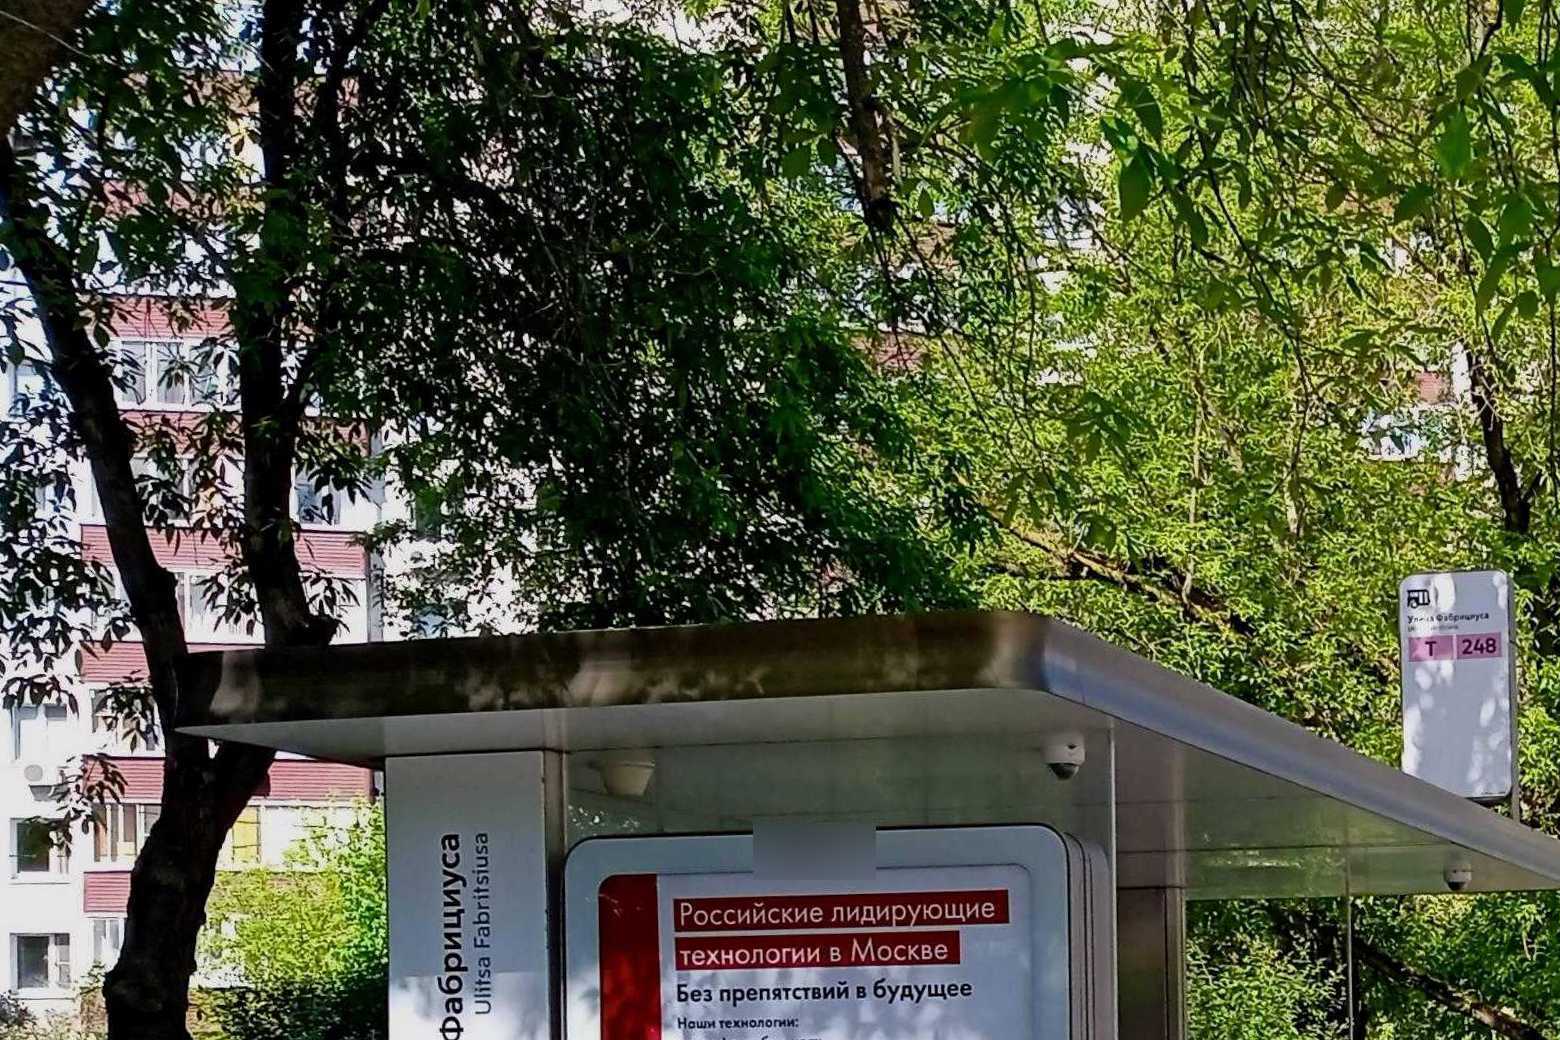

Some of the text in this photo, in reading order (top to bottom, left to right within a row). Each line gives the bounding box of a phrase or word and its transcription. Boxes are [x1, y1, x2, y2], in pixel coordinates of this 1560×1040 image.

[1462, 637, 1497, 655] 248
[472, 832, 492, 1015] Ulitsa Fabritsiusa
[680, 900, 995, 928] Российские лидирующие
[680, 937, 949, 966] технологии в Москве
[677, 977, 973, 1006] Без препятствий в будущее
[677, 1017, 800, 1030] Наши технологии:
